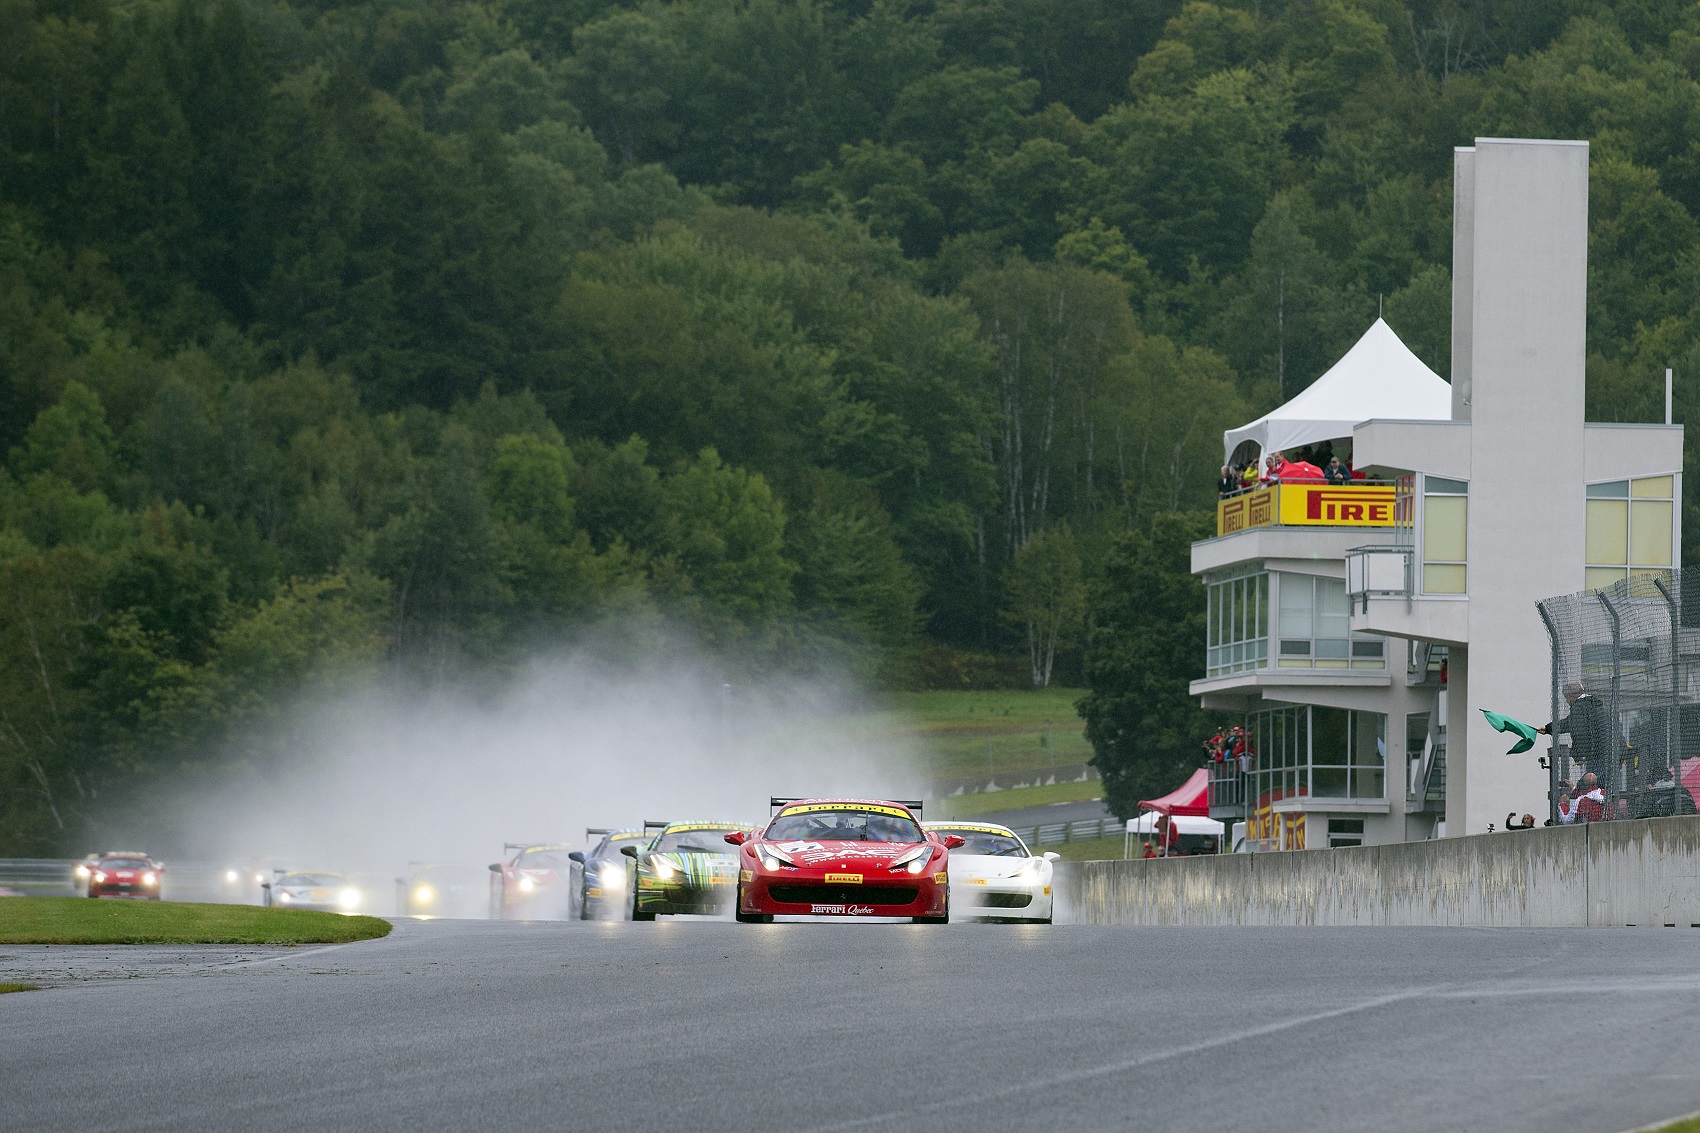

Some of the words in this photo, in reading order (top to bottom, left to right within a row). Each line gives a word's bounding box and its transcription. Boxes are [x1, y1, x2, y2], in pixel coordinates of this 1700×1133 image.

[1223, 500, 1244, 534] PIRELLI
[1249, 492, 1271, 527] PIRELLI
[811, 904, 846, 914] Ferrari
